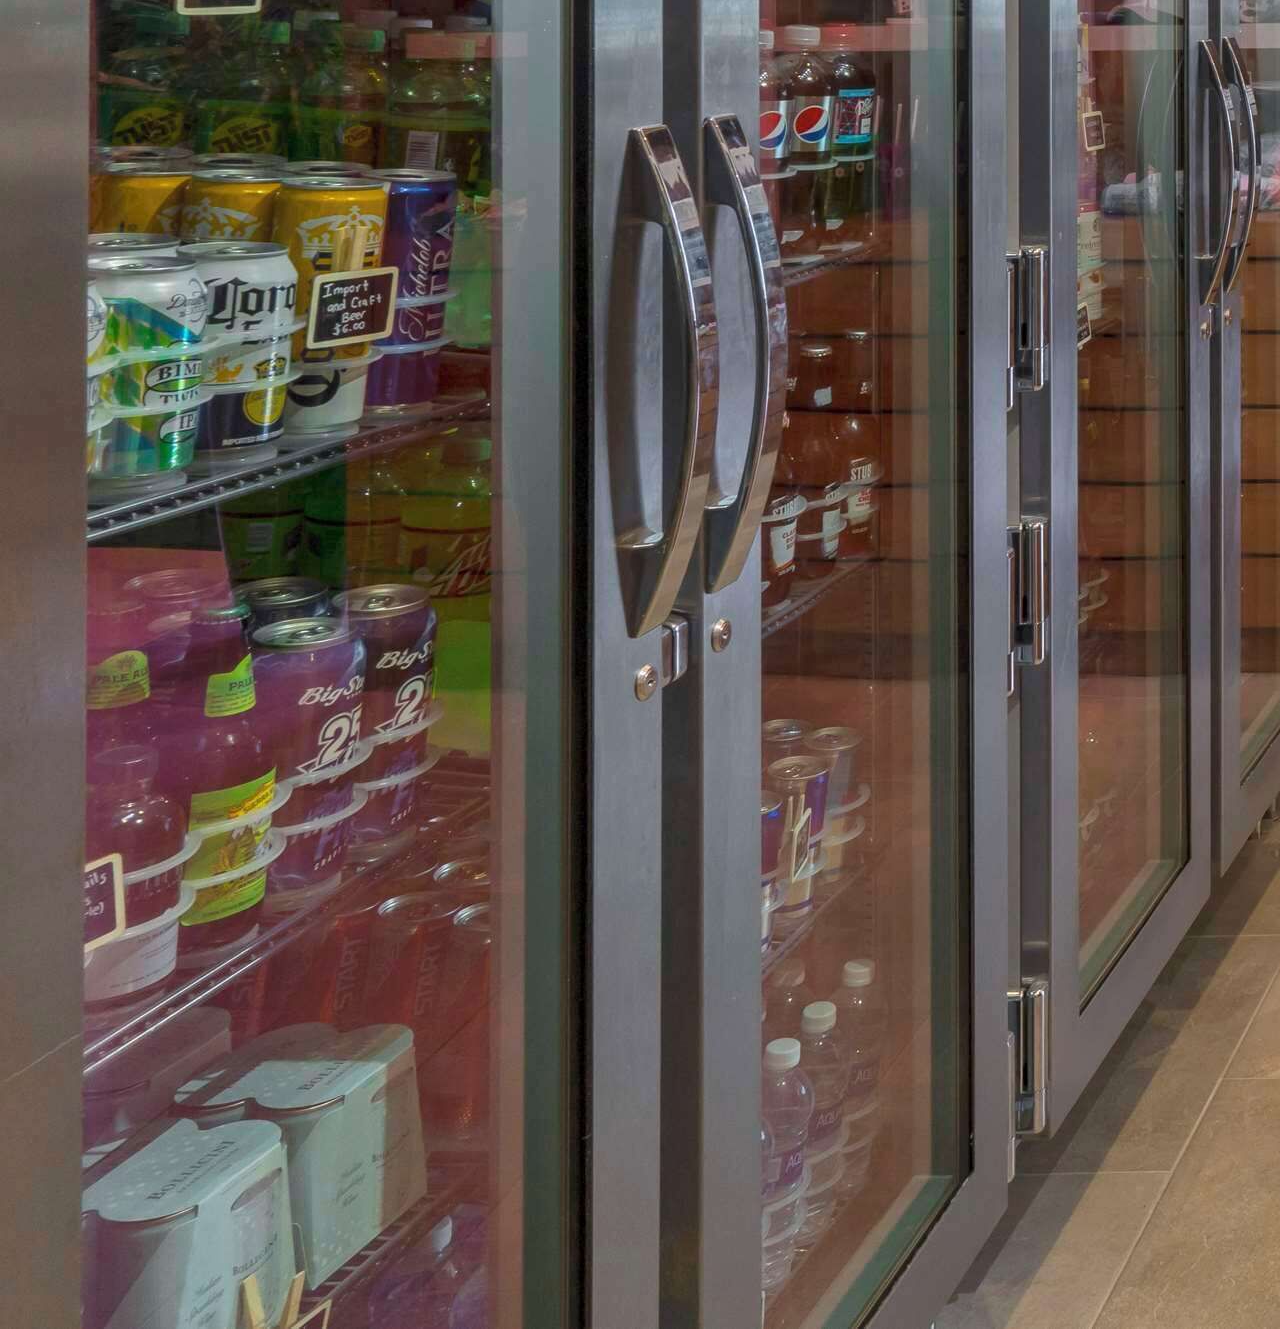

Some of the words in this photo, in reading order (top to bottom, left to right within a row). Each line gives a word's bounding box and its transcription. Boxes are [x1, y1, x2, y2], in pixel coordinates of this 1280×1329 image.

[322, 279, 369, 299] Import
[327, 300, 347, 312] and
[341, 310, 367, 324] Beer
[332, 322, 366, 336] $6.00
